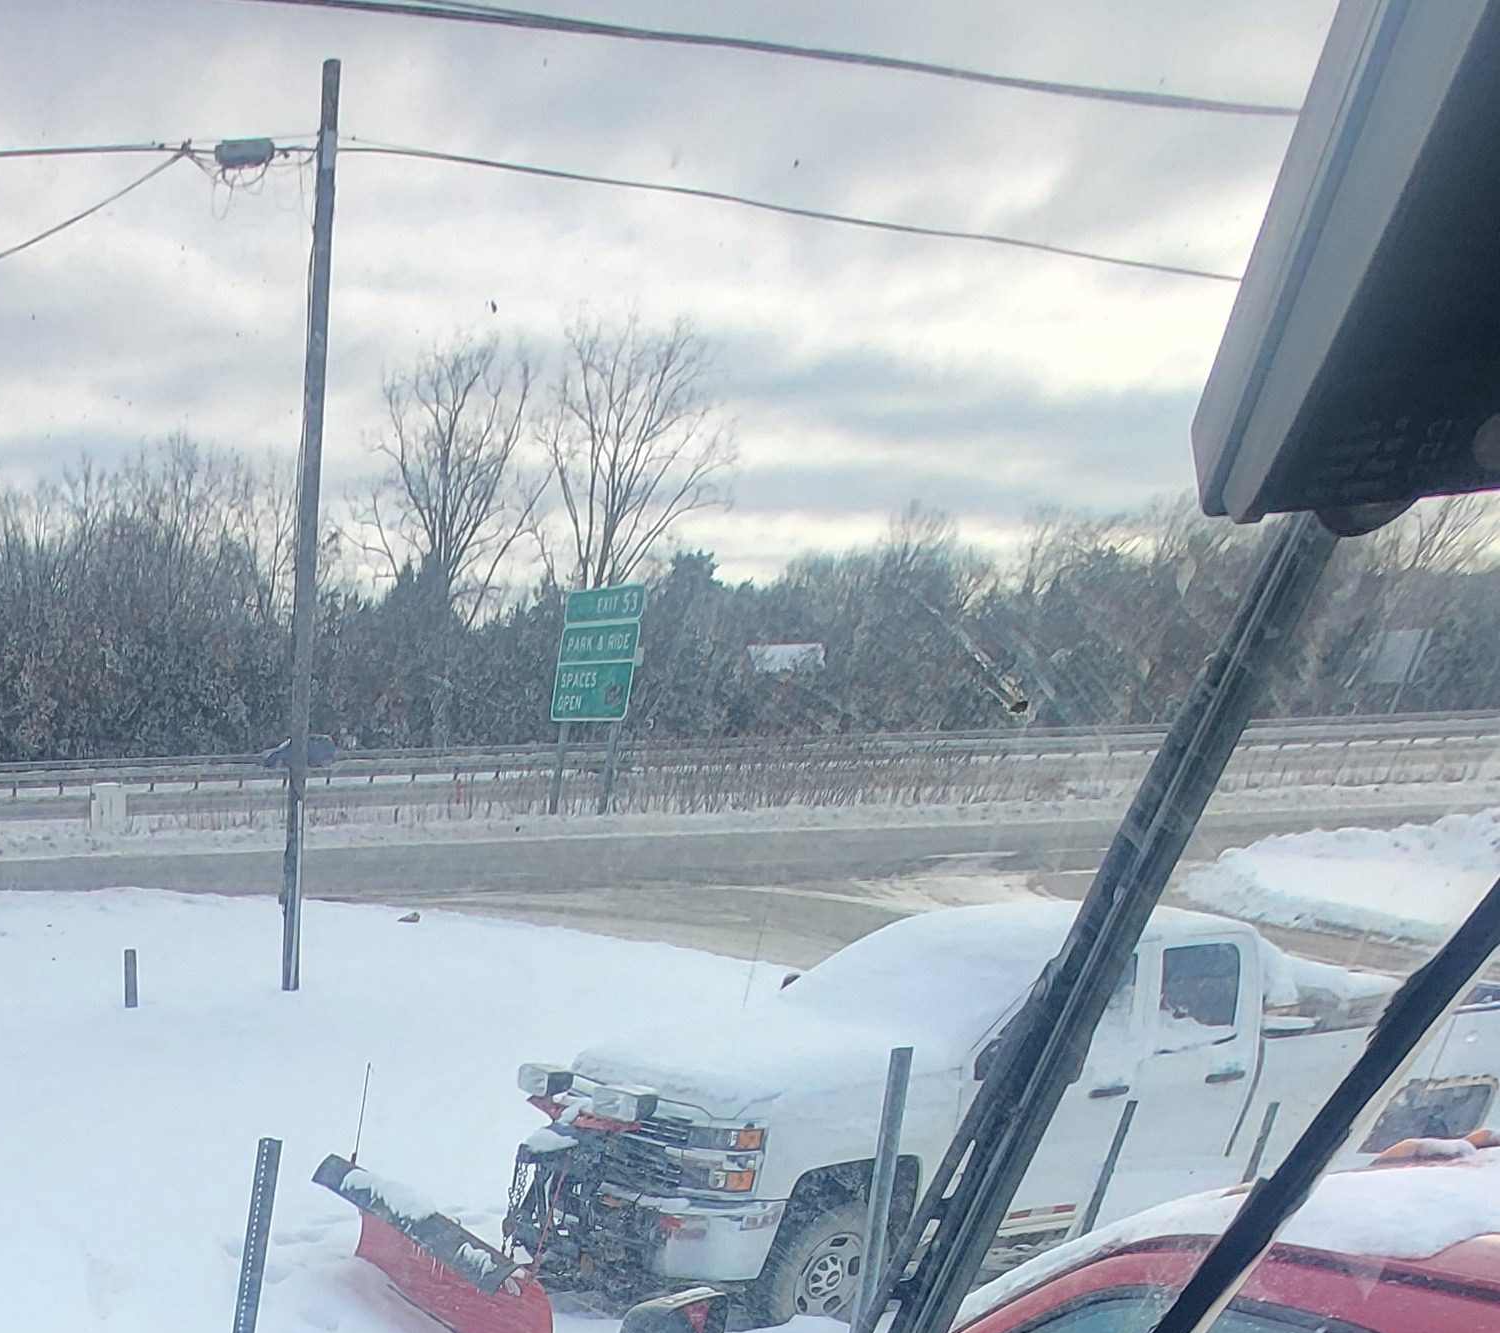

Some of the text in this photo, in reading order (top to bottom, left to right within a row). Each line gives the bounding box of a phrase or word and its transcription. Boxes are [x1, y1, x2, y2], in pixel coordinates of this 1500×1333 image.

[597, 592, 638, 613] EXIT 53
[567, 633, 630, 652] PARK & RIDE
[560, 671, 597, 688] SPACES
[557, 695, 582, 711] OPEN
